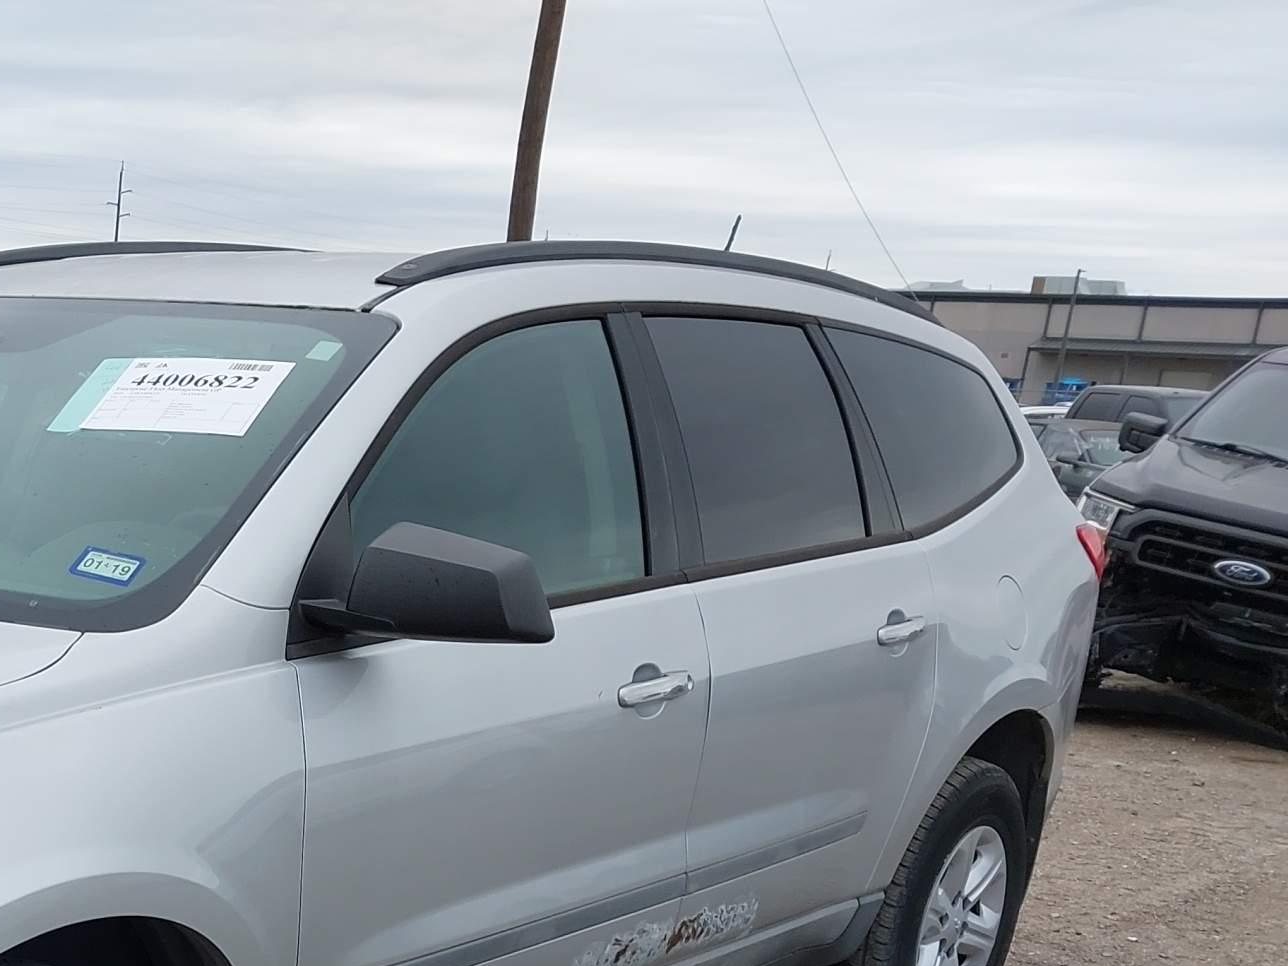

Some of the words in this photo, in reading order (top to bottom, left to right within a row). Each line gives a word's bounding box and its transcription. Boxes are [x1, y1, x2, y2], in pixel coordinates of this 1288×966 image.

[131, 373, 260, 389] 44006822
[83, 557, 104, 570] 01
[111, 562, 132, 576] 19
